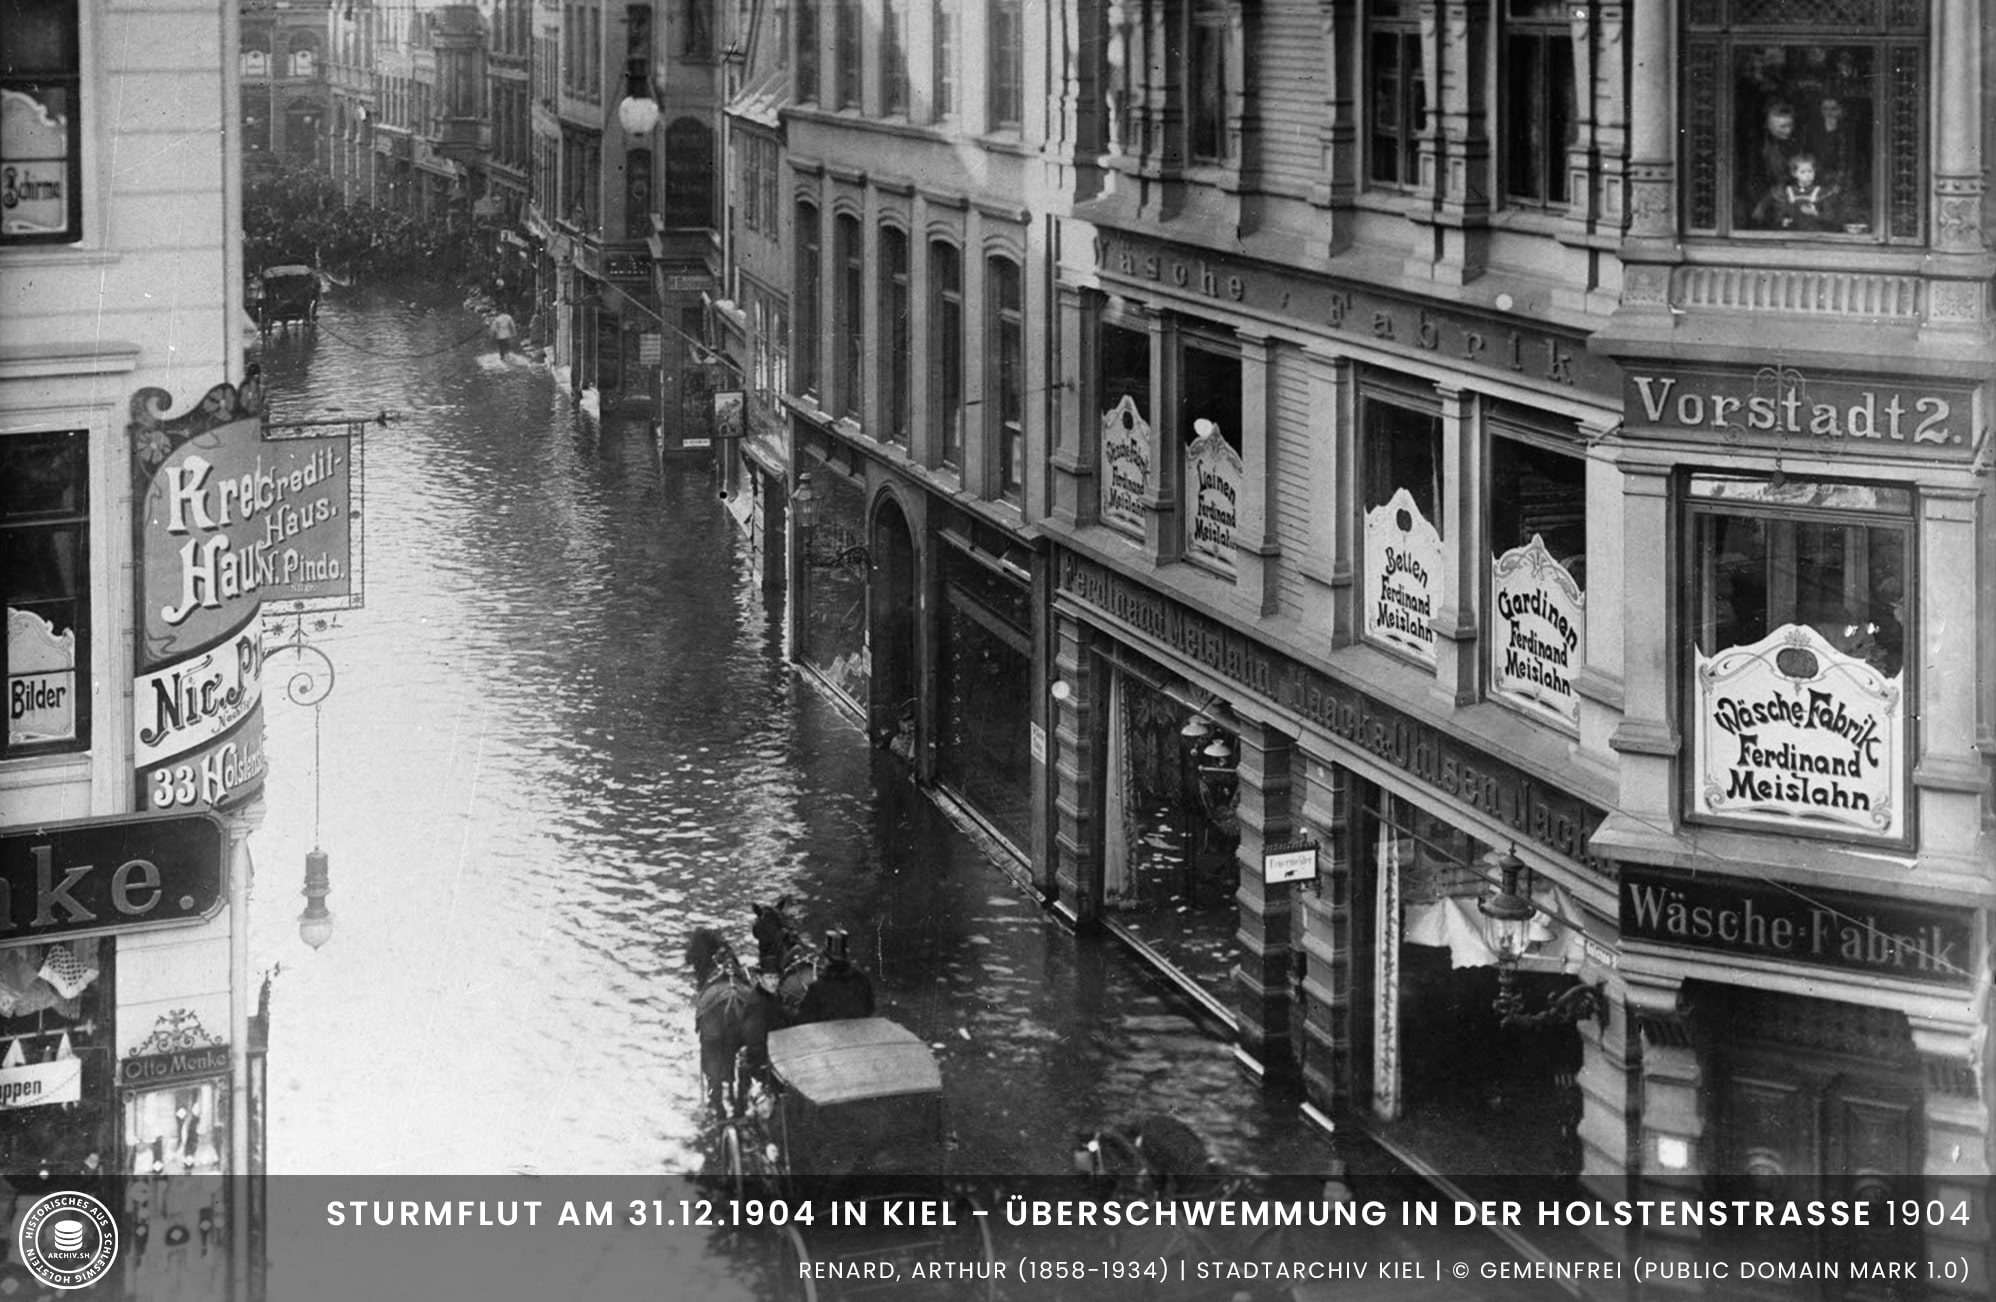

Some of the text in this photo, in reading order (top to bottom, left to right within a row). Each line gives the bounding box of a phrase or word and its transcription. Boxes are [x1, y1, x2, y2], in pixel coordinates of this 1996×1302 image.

[1633, 376, 1962, 445] Vorstadt 2.
[1196, 458, 1236, 506] Leinen
[259, 497, 338, 550] Haus.
[1197, 494, 1237, 529] Ferdinand
[283, 548, 345, 585] Pindo.
[1381, 574, 1431, 618] Ferdinand
[1376, 600, 1433, 644] Meislahn
[1498, 587, 1578, 652] Gardinen
[1509, 617, 1568, 669] Ferdinand
[1505, 647, 1571, 697] Meislahn
[11, 678, 66, 721] Bilder
[140, 655, 225, 747] Nic.
[1736, 733, 1862, 778] Ferdinand
[154, 765, 198, 809] 33
[1726, 768, 1870, 812] Meislahn
[125, 1059, 167, 1078] Otto
[0, 1079, 42, 1105] ppen
